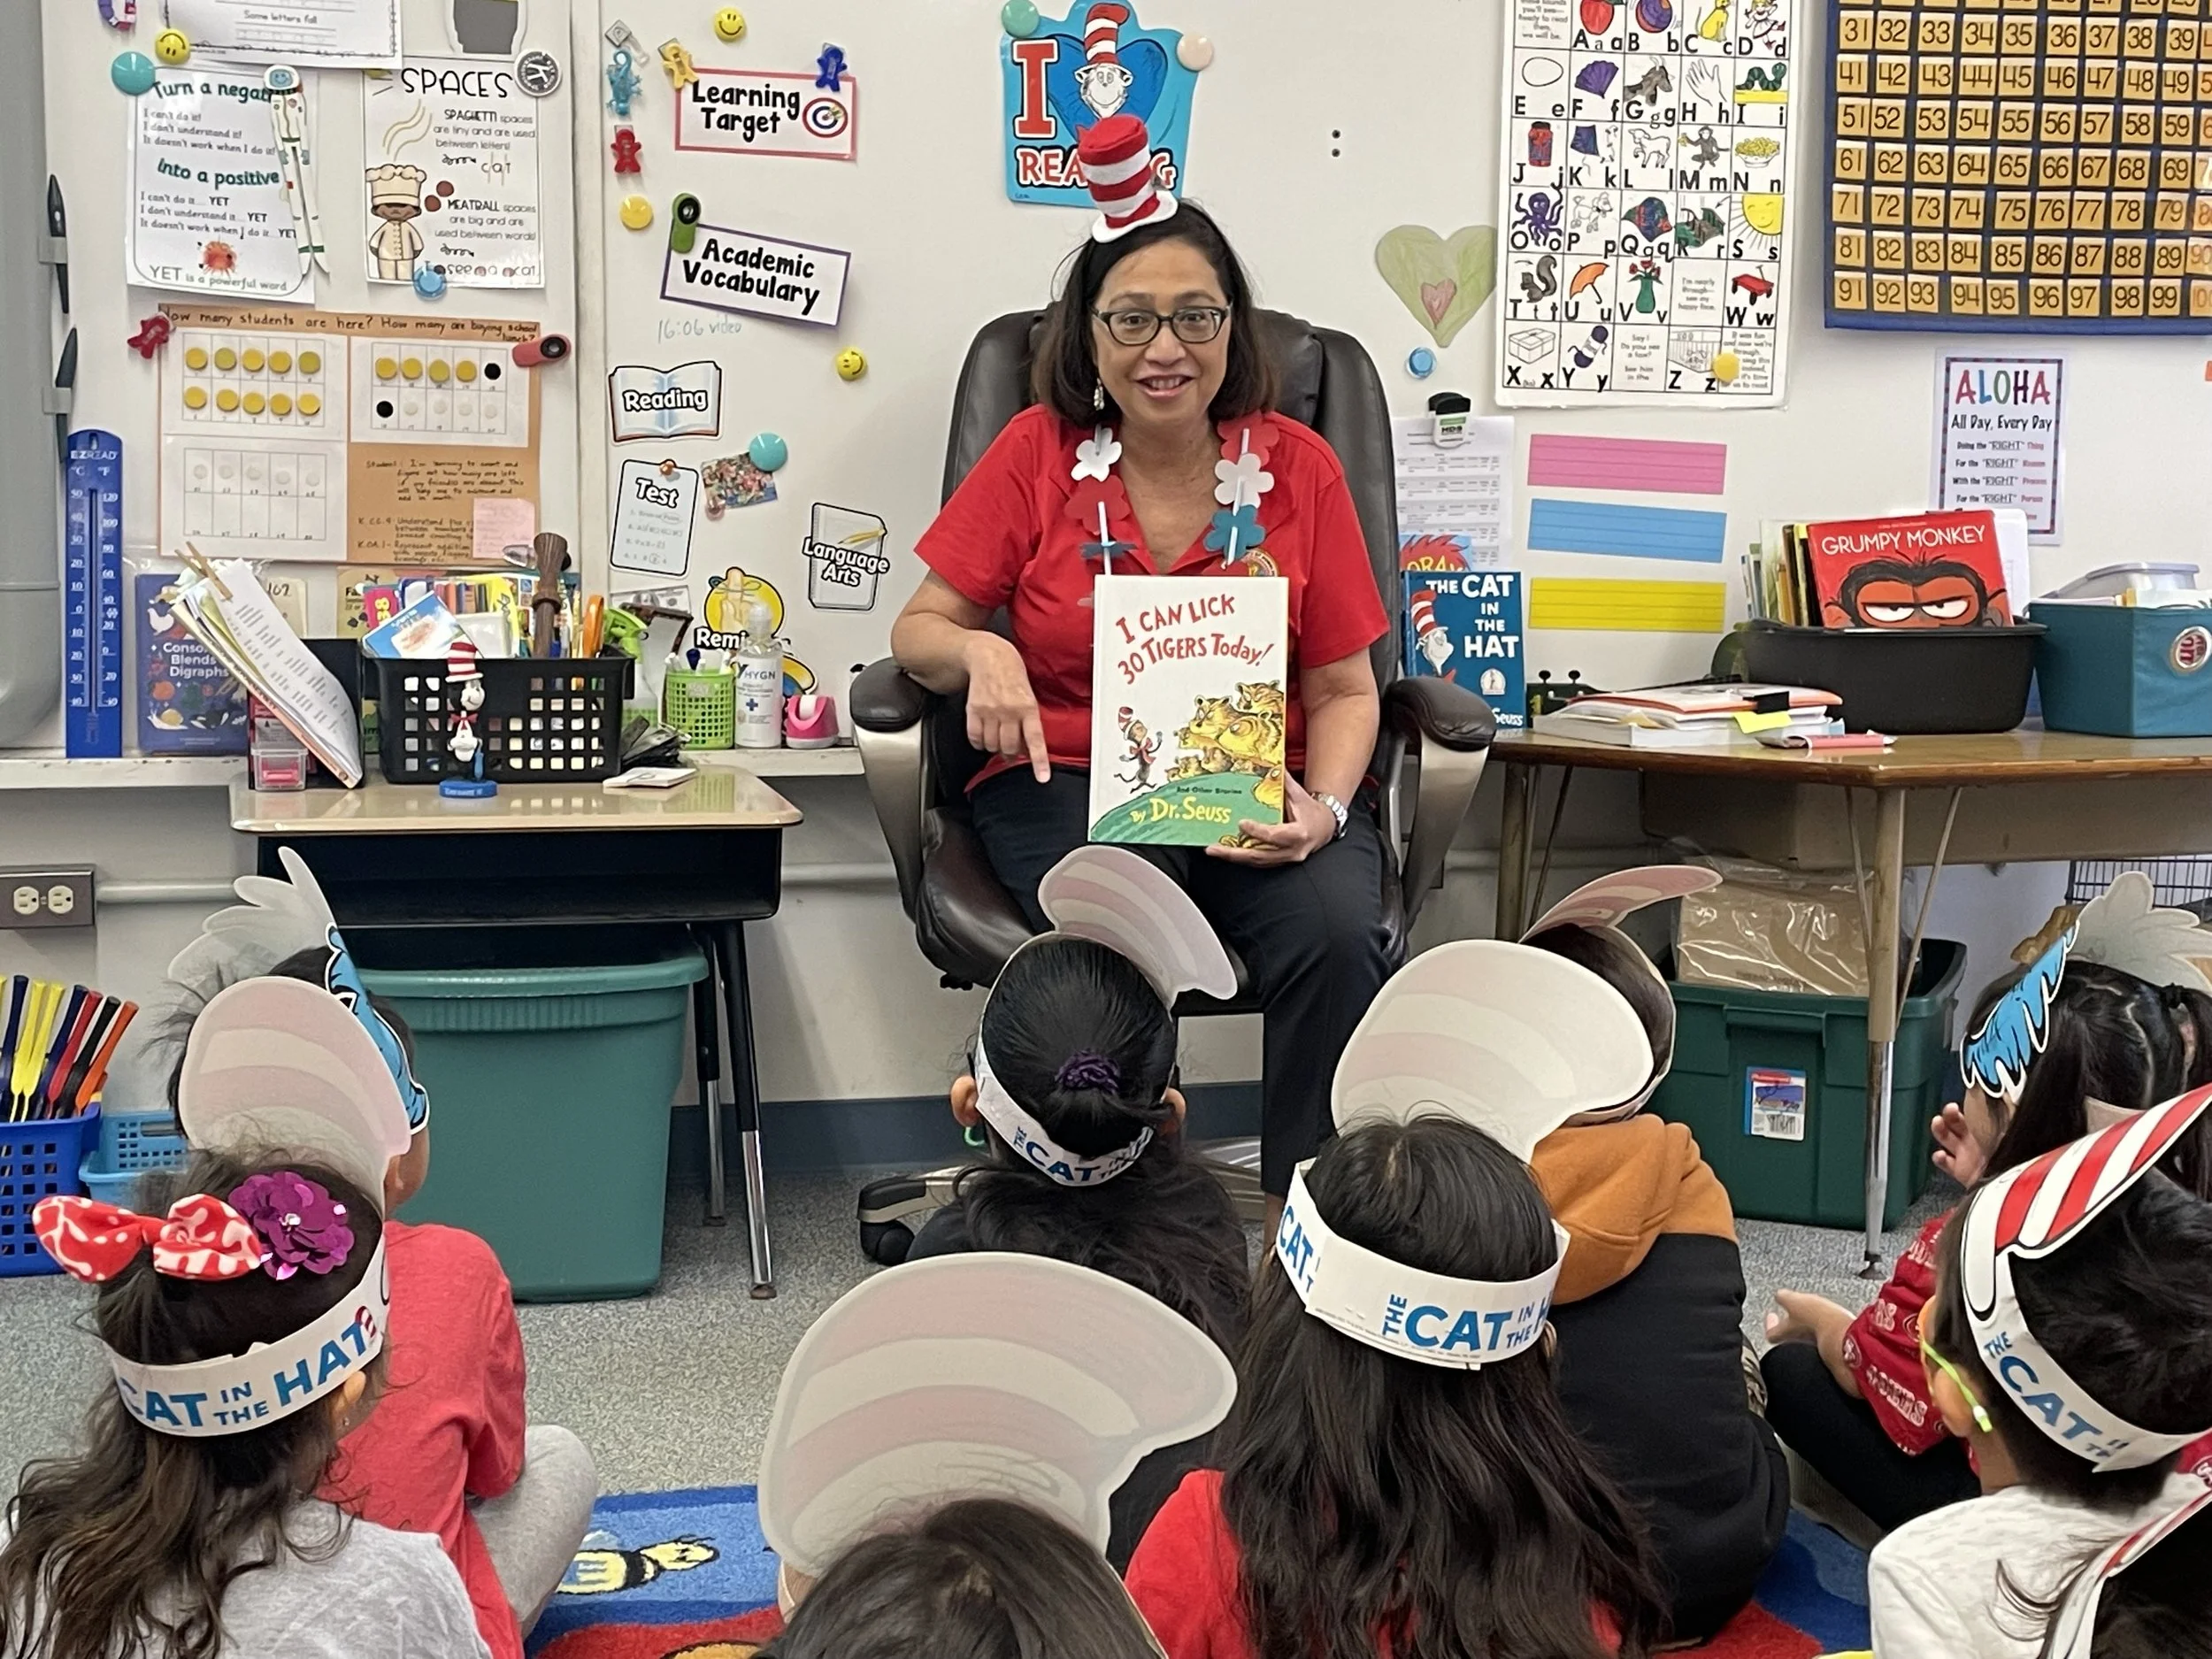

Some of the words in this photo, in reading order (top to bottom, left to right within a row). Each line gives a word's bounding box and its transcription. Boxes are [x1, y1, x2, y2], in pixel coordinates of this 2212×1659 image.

[1844, 18, 1868, 42] 31
[1878, 18, 1908, 42] 32
[1922, 19, 1951, 44] 33
[1964, 21, 1994, 46] 34
[2005, 22, 2033, 47] 35
[2050, 24, 2078, 49] 36
[2088, 24, 2116, 49] 37
[2127, 26, 2154, 50] 38
[2169, 27, 2196, 52] 39
[152, 81, 194, 99] Turn
[200, 82, 212, 94] a
[401, 67, 513, 98] SPACES
[1015, 41, 1056, 136] I
[692, 83, 801, 120] Learning
[1515, 96, 1525, 116] E
[1552, 104, 1564, 117] e
[1571, 98, 1583, 119] F
[1610, 98, 1619, 121] f
[1625, 100, 1643, 120] G
[1682, 102, 1696, 122] H
[1718, 103, 1729, 124] h
[701, 107, 780, 143] Target
[1842, 104, 1865, 128] 51
[1873, 105, 1901, 130] 52
[1917, 107, 1947, 132] 53
[1958, 107, 1989, 131] 54
[2001, 109, 2030, 134] 55
[2044, 111, 2071, 135] 56
[2083, 111, 2110, 135] 57
[2124, 112, 2151, 136] 58
[2164, 113, 2190, 138] 59
[157, 157, 191, 180] Into
[197, 172, 208, 183] a
[215, 171, 280, 190] positive
[209, 196, 229, 207] YET
[448, 199, 500, 211] MEATBALL
[247, 212, 267, 223] YET
[702, 237, 815, 279] Academic
[150, 265, 182, 281] YET
[185, 273, 195, 284] is
[197, 275, 205, 285] a
[208, 274, 257, 292] powerful
[259, 280, 288, 293] word
[683, 259, 819, 316] Vocabulary
[1839, 278, 1862, 302] 91
[1876, 281, 1901, 305] 92
[1909, 281, 1935, 306] 93
[1953, 283, 1980, 307] 94
[1990, 286, 2016, 311] 95
[2033, 285, 2060, 309] 96
[200, 313, 233, 326] many
[240, 312, 294, 326] students
[306, 318, 326, 328] are
[337, 316, 373, 331] here?
[381, 316, 409, 329] How
[415, 320, 446, 335] many
[709, 314, 742, 334] video
[624, 388, 708, 412] Reading
[1955, 369, 2050, 405] ALOHA
[1951, 414, 1966, 430] All
[1970, 414, 1993, 432] Day,
[1997, 414, 2028, 432] Every
[2032, 415, 2053, 432] Day
[635, 478, 680, 508] Test
[803, 535, 890, 575] Language
[1821, 532, 1901, 556] GRUMPY
[1907, 525, 1985, 549] MONKEY
[823, 565, 863, 588] Arts
[1425, 580, 1459, 595] THE
[1461, 574, 1514, 598] CAT
[1116, 617, 1136, 644] I
[1139, 603, 1183, 633] CAN
[1188, 593, 1235, 625] LICK
[1480, 603, 1500, 616] IN
[1474, 618, 1506, 633] THE
[171, 654, 217, 665] Blends
[1118, 651, 1145, 685] 30
[1141, 636, 1207, 665] TIGERS
[1210, 633, 1275, 667] Today!
[1463, 634, 1519, 659] HAT
[169, 666, 229, 679] Digraphs
[1149, 797, 1180, 823] Dr.
[1182, 795, 1232, 825] Seuss
[1013, 1125, 1027, 1148] THE
[1025, 1141, 1101, 1182] CAT
[1279, 1205, 1313, 1280] CAT
[1382, 1294, 1407, 1337] THE
[1405, 1304, 1513, 1352] CAT
[1518, 1302, 1532, 1325] IN
[1507, 1327, 1532, 1349] THE
[120, 1377, 208, 1428] CAT
[220, 1382, 252, 1403] IN
[273, 1320, 370, 1408] HAT
[1984, 1331, 2014, 1359] THE
[1999, 1355, 2103, 1440] CAT
[213, 1401, 269, 1426] THE
